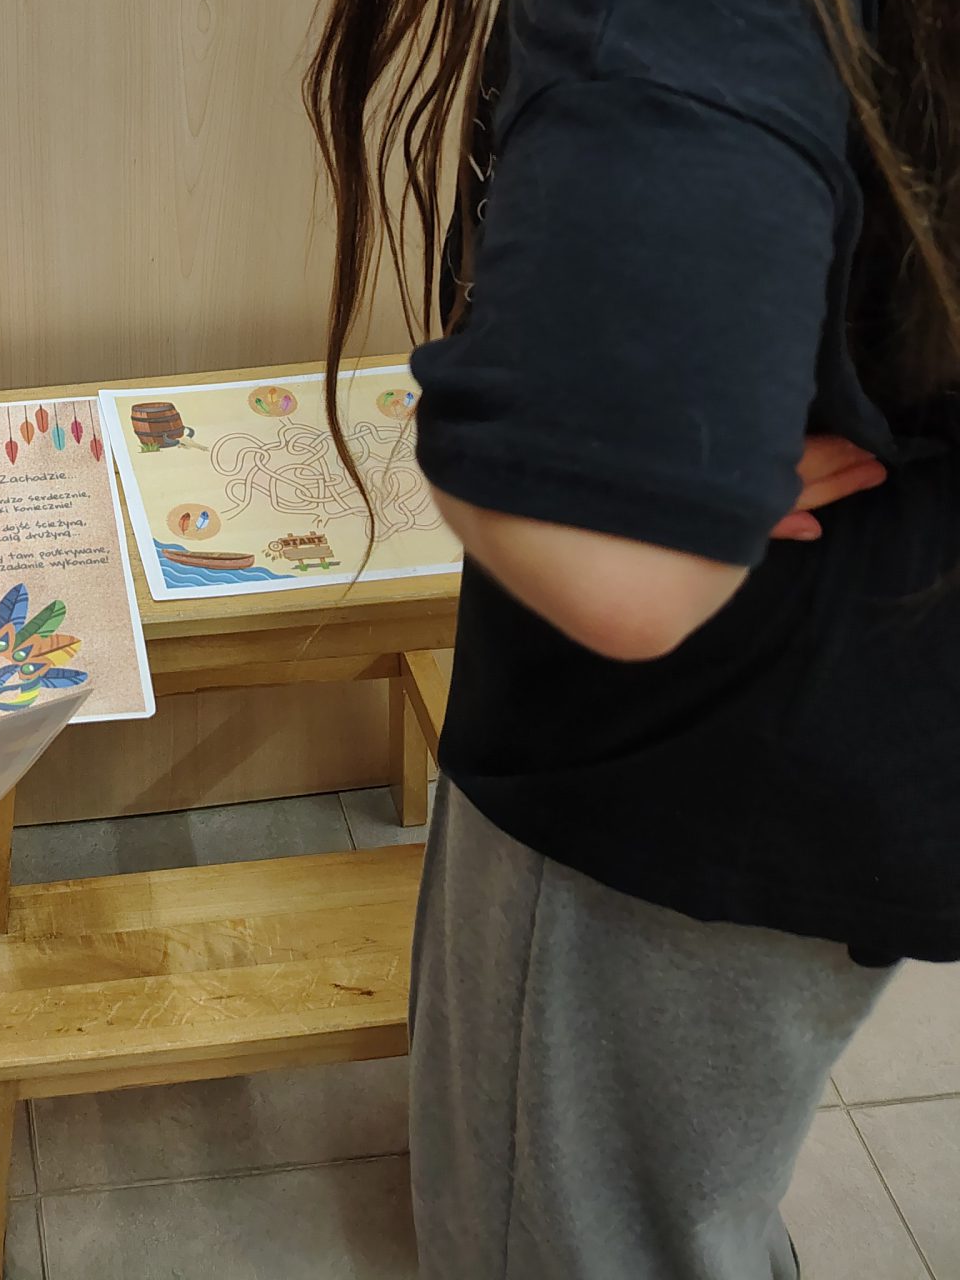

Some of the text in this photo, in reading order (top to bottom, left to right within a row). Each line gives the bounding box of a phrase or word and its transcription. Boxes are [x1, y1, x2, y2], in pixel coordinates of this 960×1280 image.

[2, 521, 31, 534] dojść
[282, 537, 324, 546] START
[8, 551, 34, 561] tam
[0, 560, 45, 572] zadanie
[50, 556, 110, 570] wykonane!
